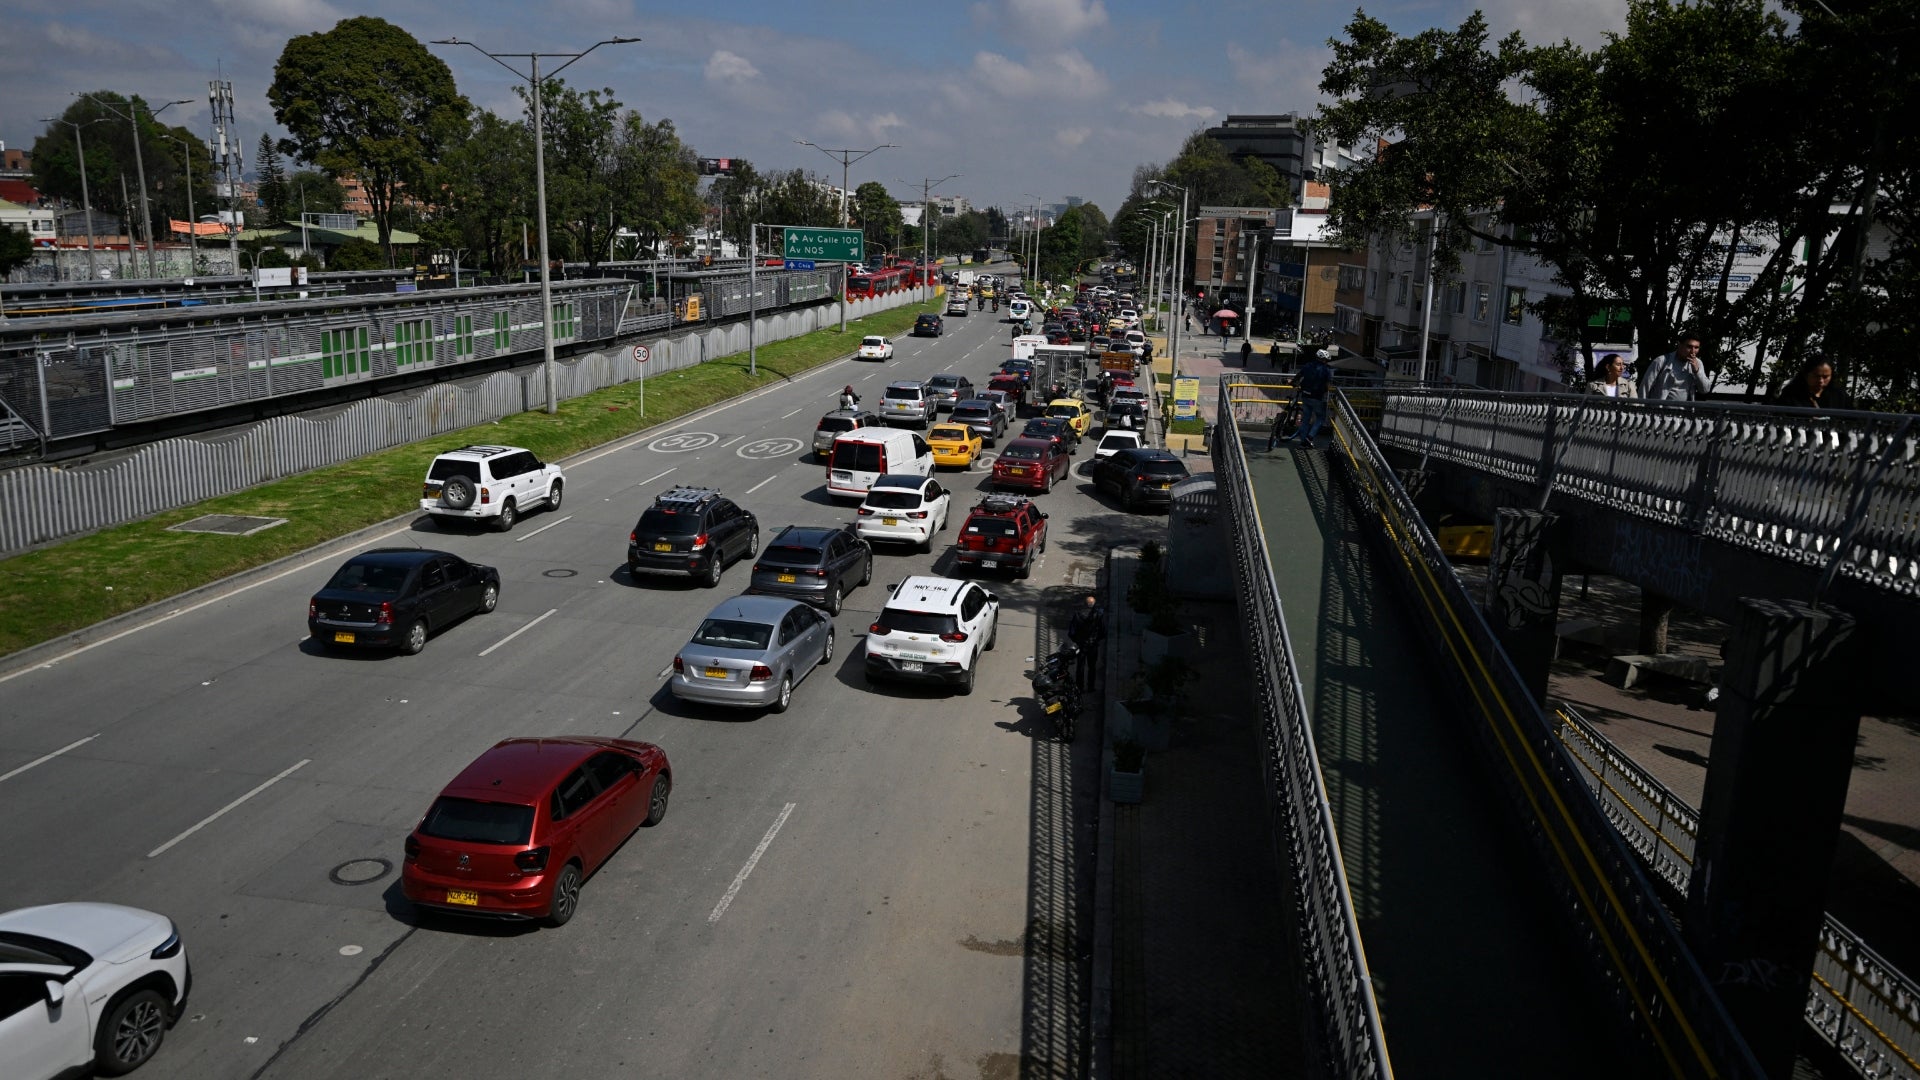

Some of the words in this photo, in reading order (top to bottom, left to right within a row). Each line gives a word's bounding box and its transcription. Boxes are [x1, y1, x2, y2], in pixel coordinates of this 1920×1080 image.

[802, 234, 814, 243] Av
[817, 235, 839, 244] Calle
[842, 236, 859, 245] 100
[789, 245, 801, 254] Av
[636, 349, 647, 358] 50
[661, 435, 708, 448] 50
[749, 441, 793, 455] 50
